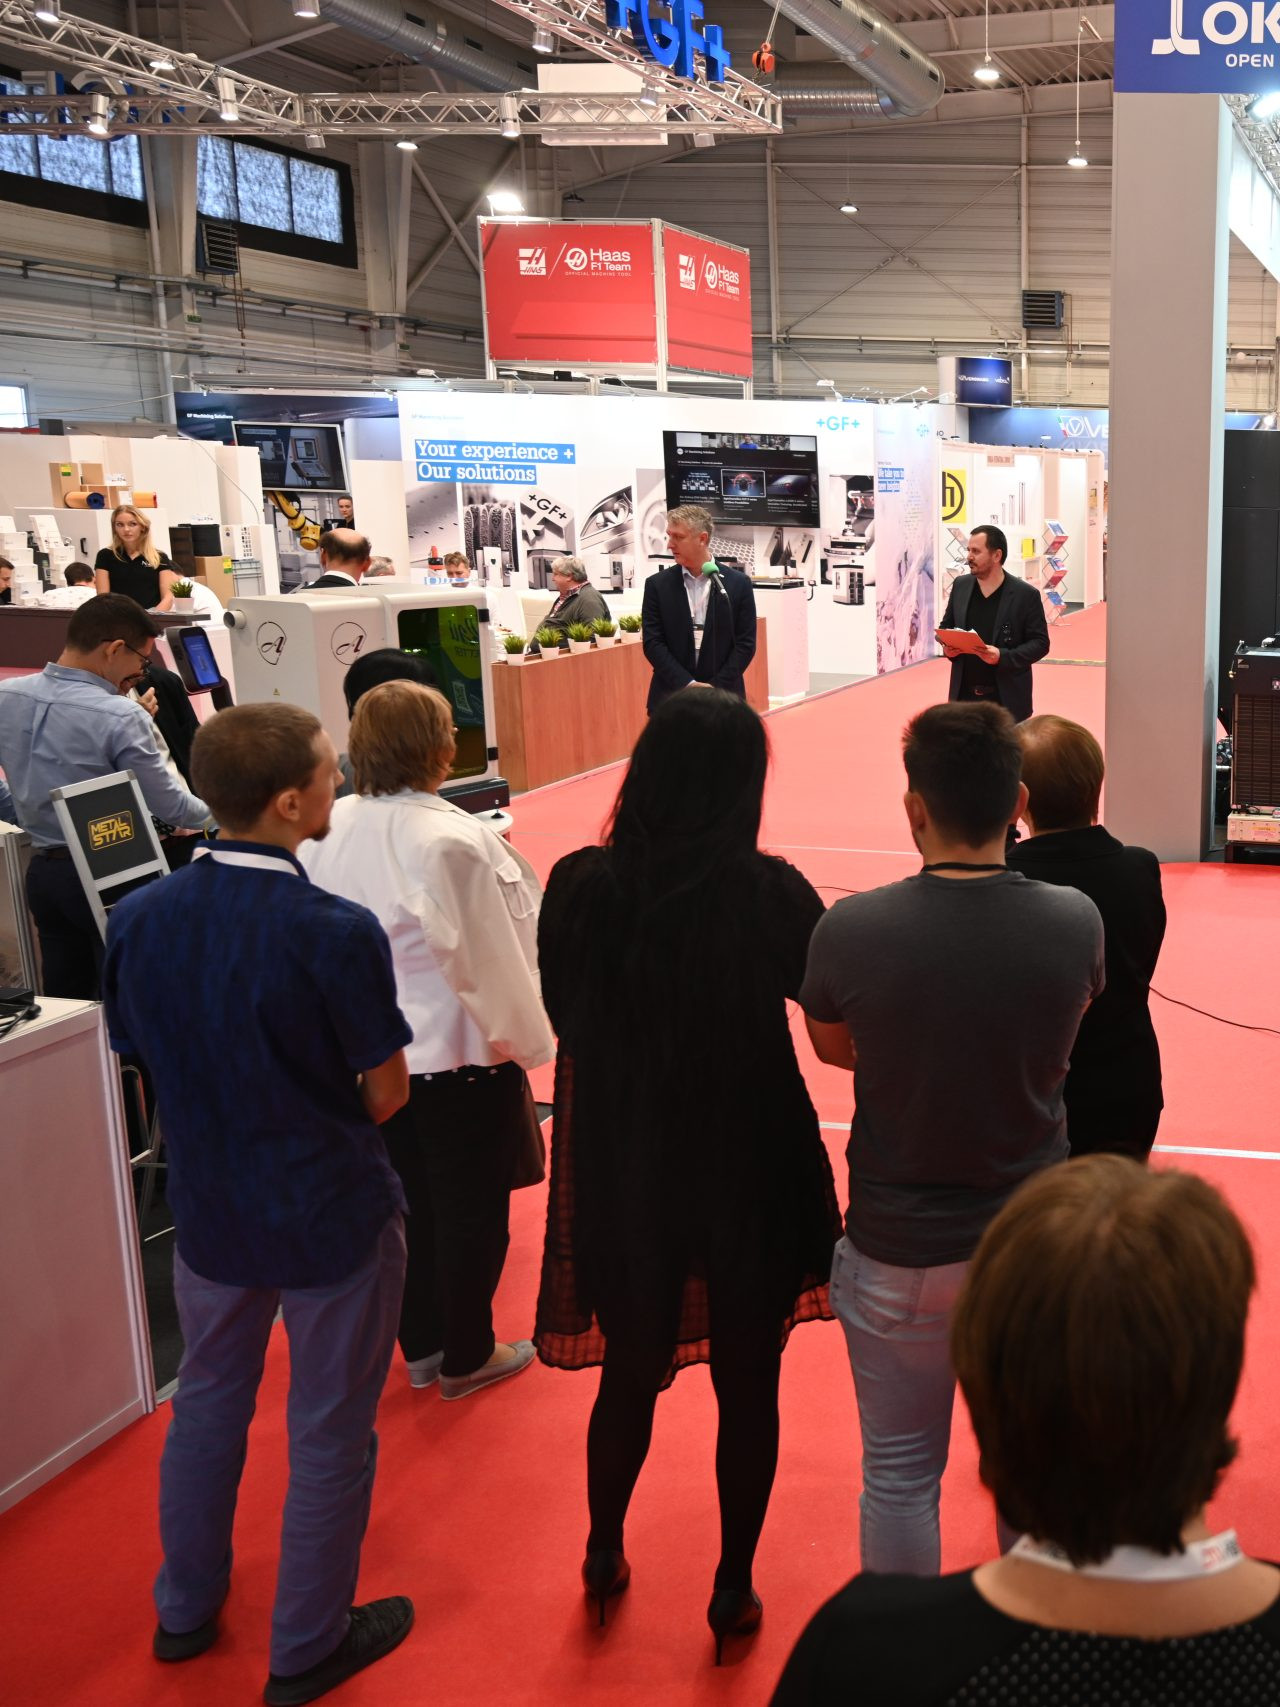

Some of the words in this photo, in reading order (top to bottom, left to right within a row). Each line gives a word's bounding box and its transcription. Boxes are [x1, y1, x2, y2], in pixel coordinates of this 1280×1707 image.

[1225, 53, 1275, 69] OPEN
[590, 248, 631, 262] Haas
[591, 263, 602, 271] F1
[604, 263, 631, 272] Team
[718, 263, 739, 285] Haas
[718, 281, 725, 291] F1
[725, 282, 740, 295] Team
[416, 440, 456, 457] Your
[462, 443, 558, 461] experience
[418, 462, 451, 479] Our
[457, 464, 535, 482] solutions
[91, 817, 128, 836] METAL
[93, 824, 132, 846] STAR
